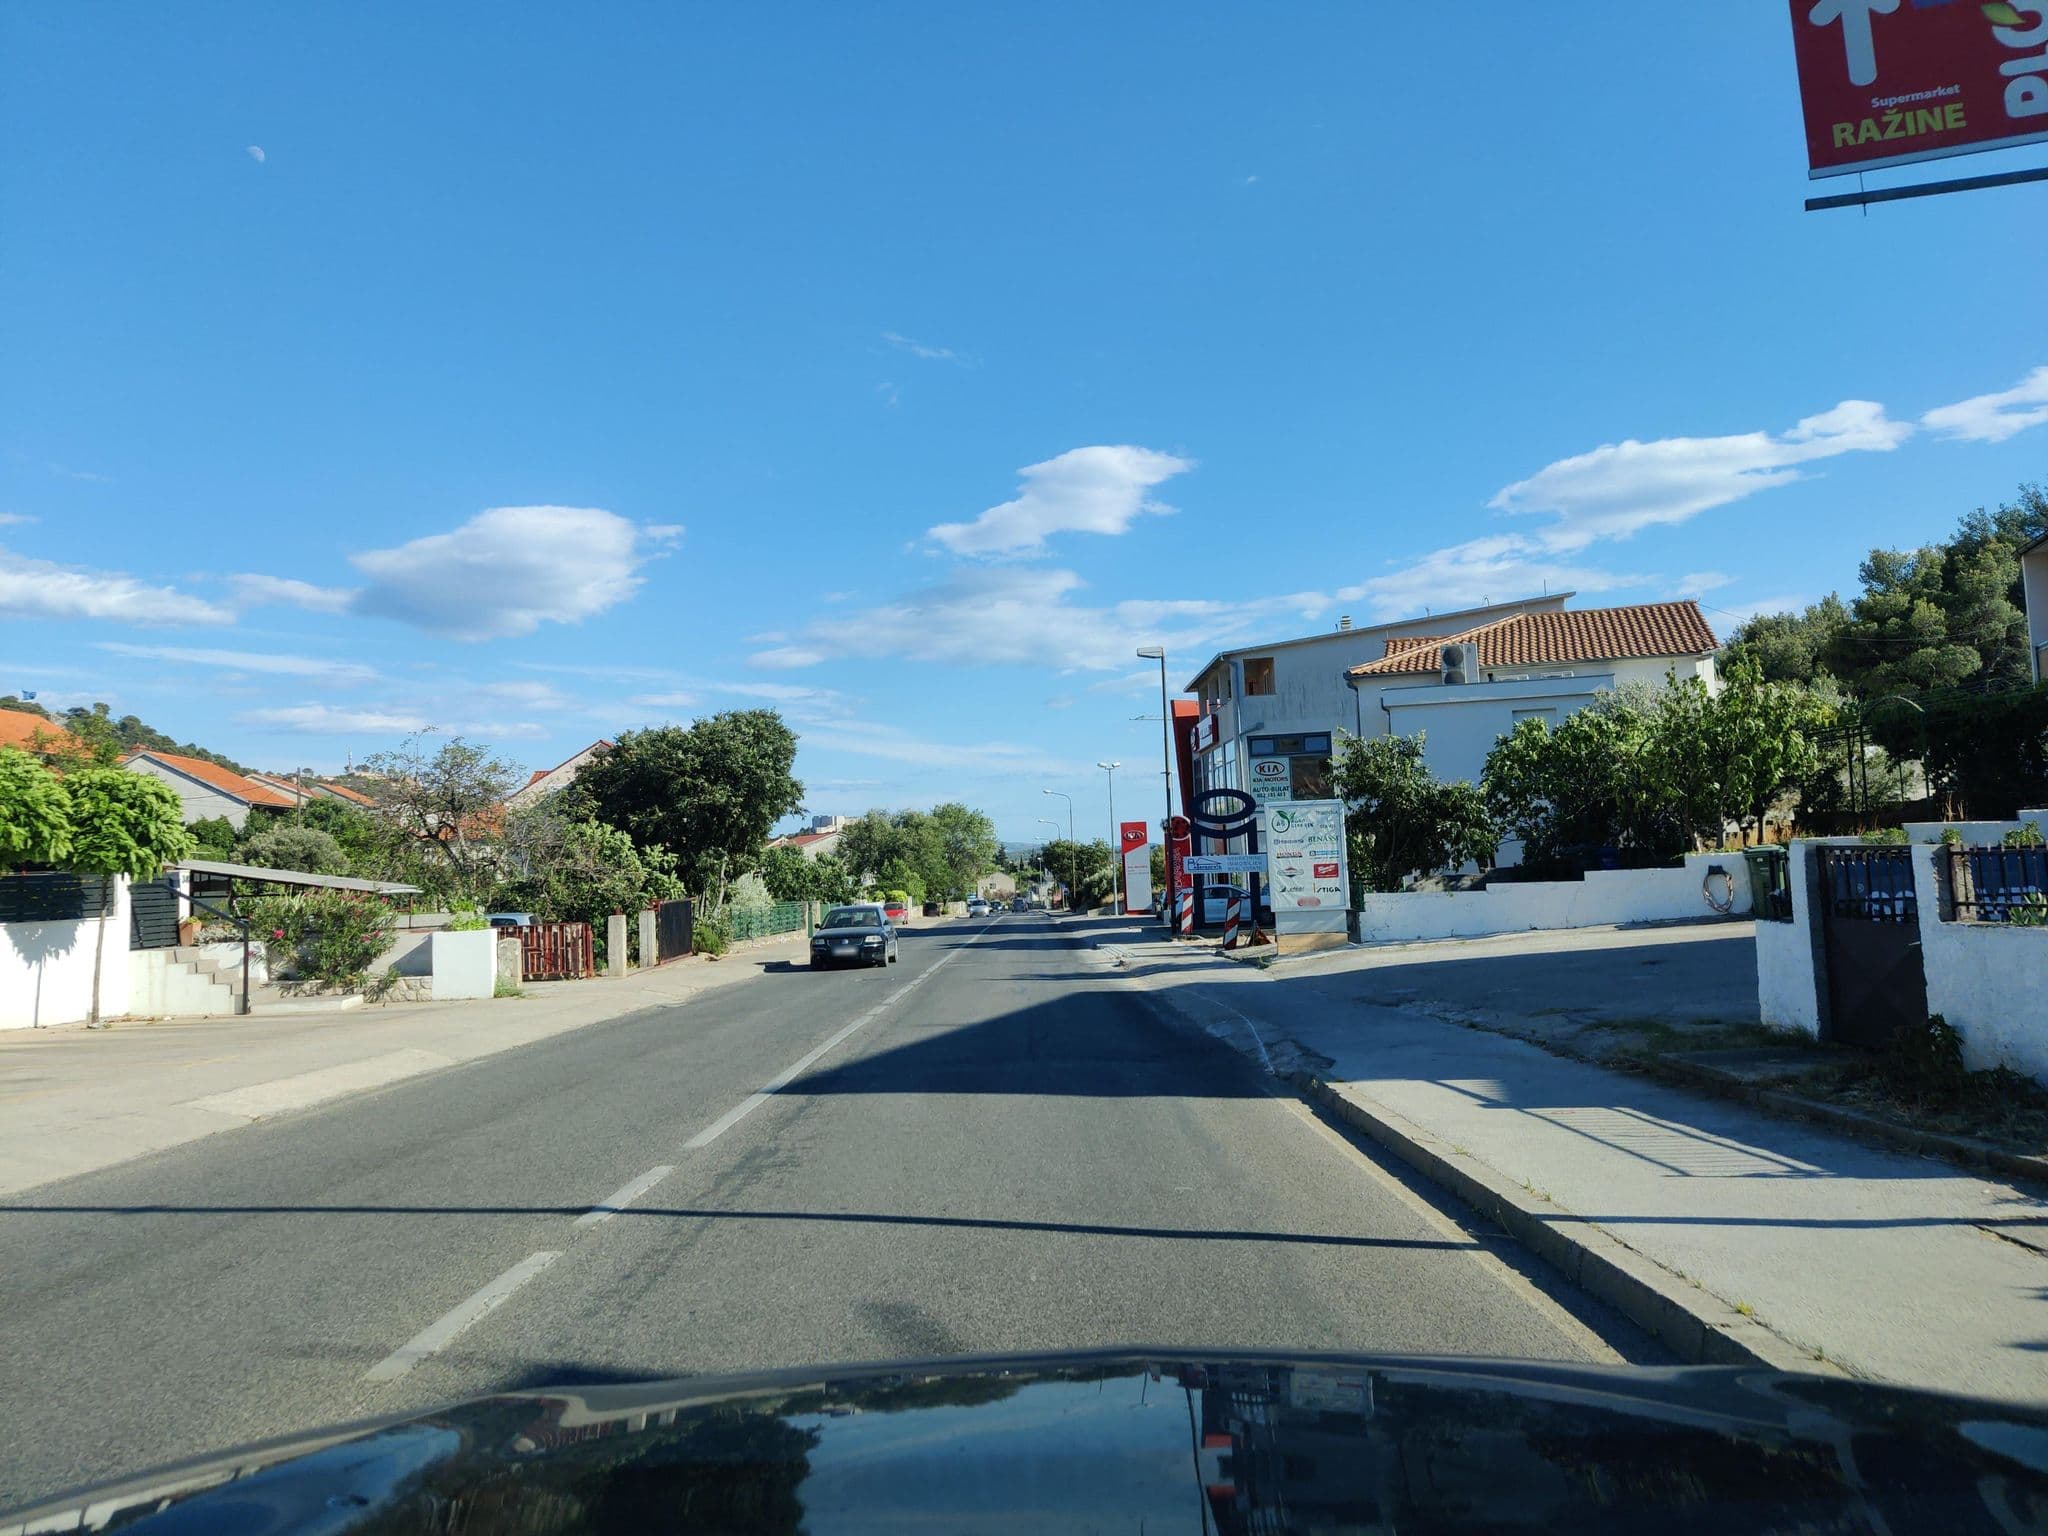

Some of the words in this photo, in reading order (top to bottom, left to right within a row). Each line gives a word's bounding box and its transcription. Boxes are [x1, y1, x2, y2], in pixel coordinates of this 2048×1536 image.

[1871, 84, 1961, 108] Supermarket
[1832, 102, 1967, 148] RAŽINE
[1258, 764, 1280, 774] KIA
